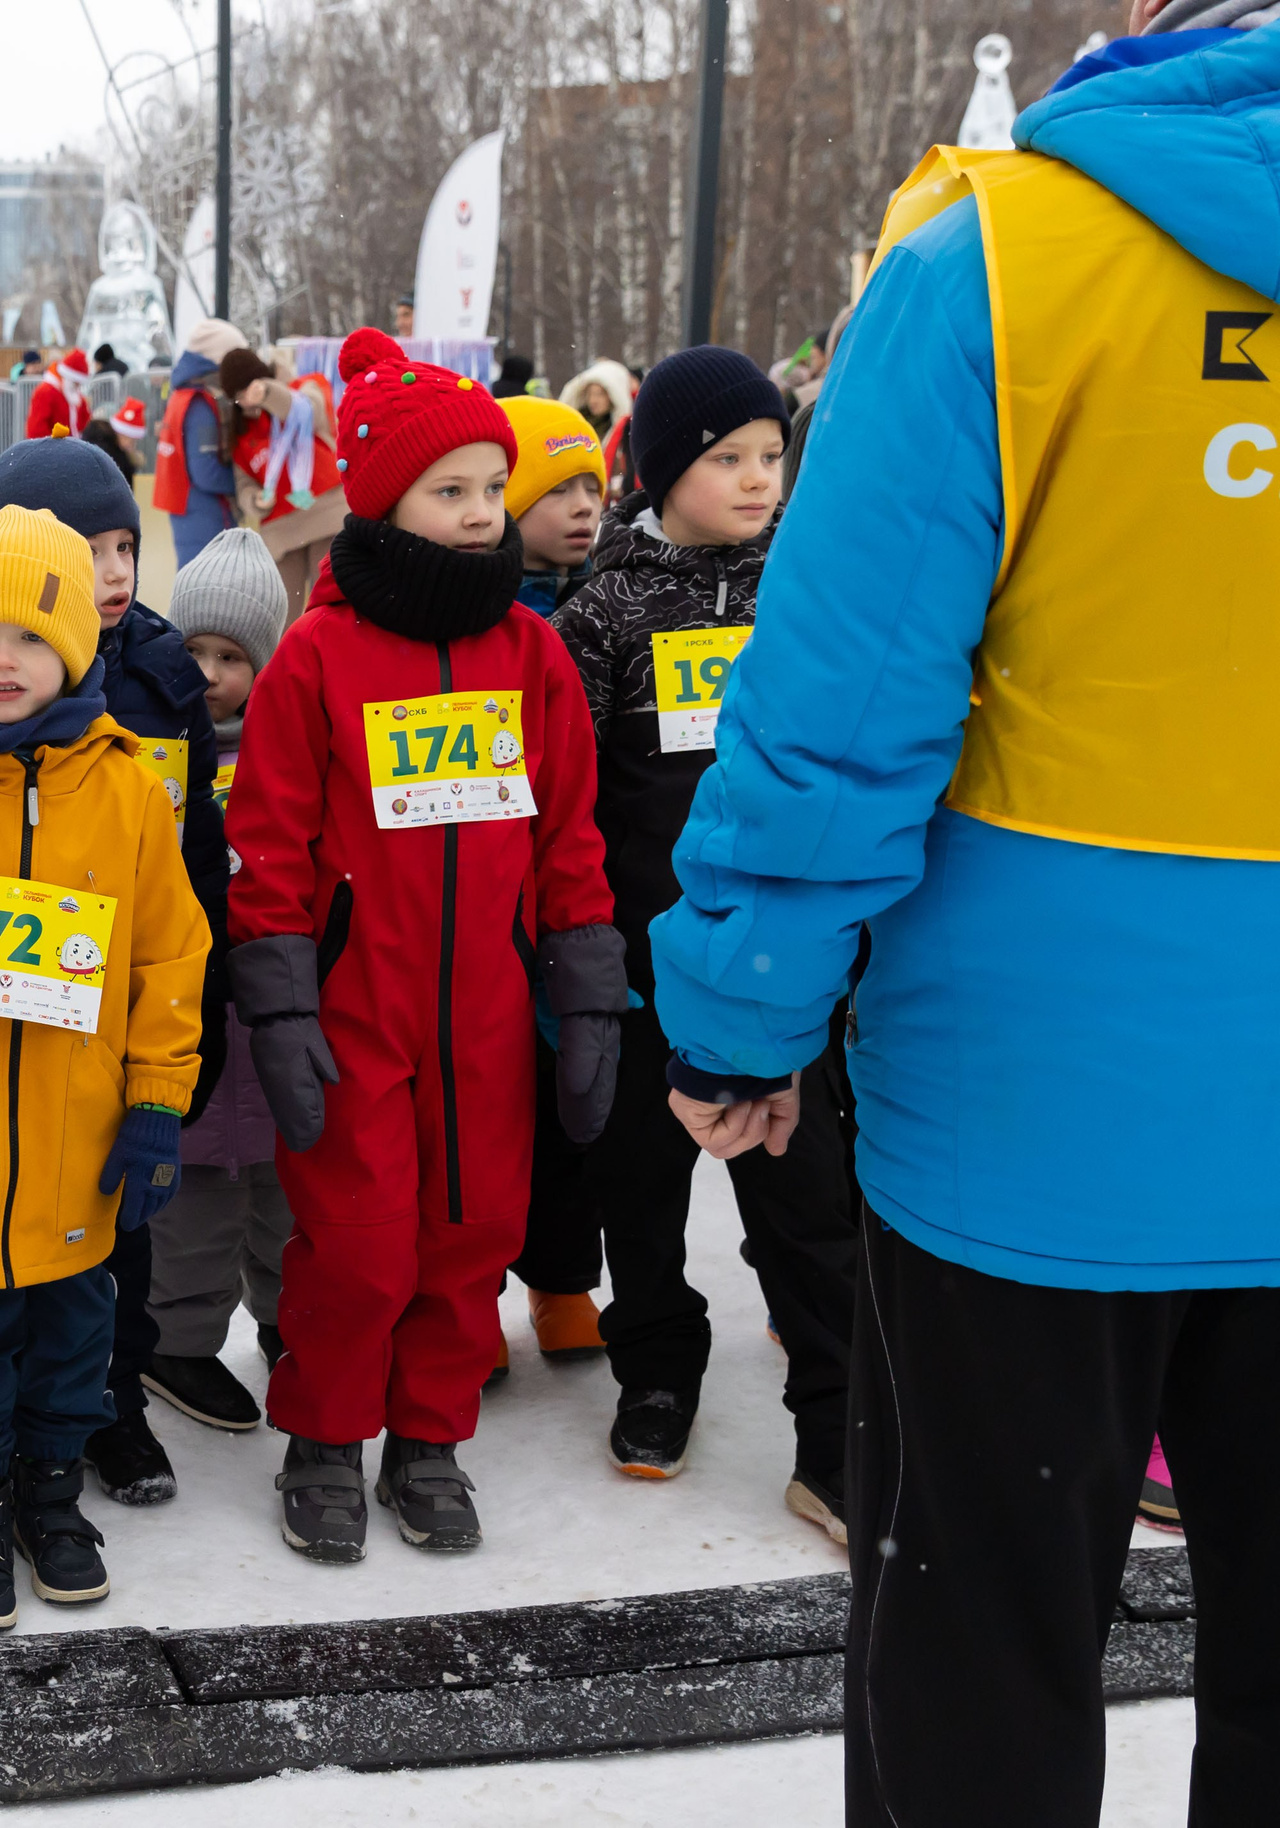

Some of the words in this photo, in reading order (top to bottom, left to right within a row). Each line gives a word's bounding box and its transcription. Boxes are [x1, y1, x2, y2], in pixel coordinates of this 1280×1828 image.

[1203, 423, 1280, 498] С
[674, 656, 732, 704] 19
[407, 708, 427, 716] СХБ
[389, 724, 478, 777] 174
[22, 895, 45, 904] КУБОК
